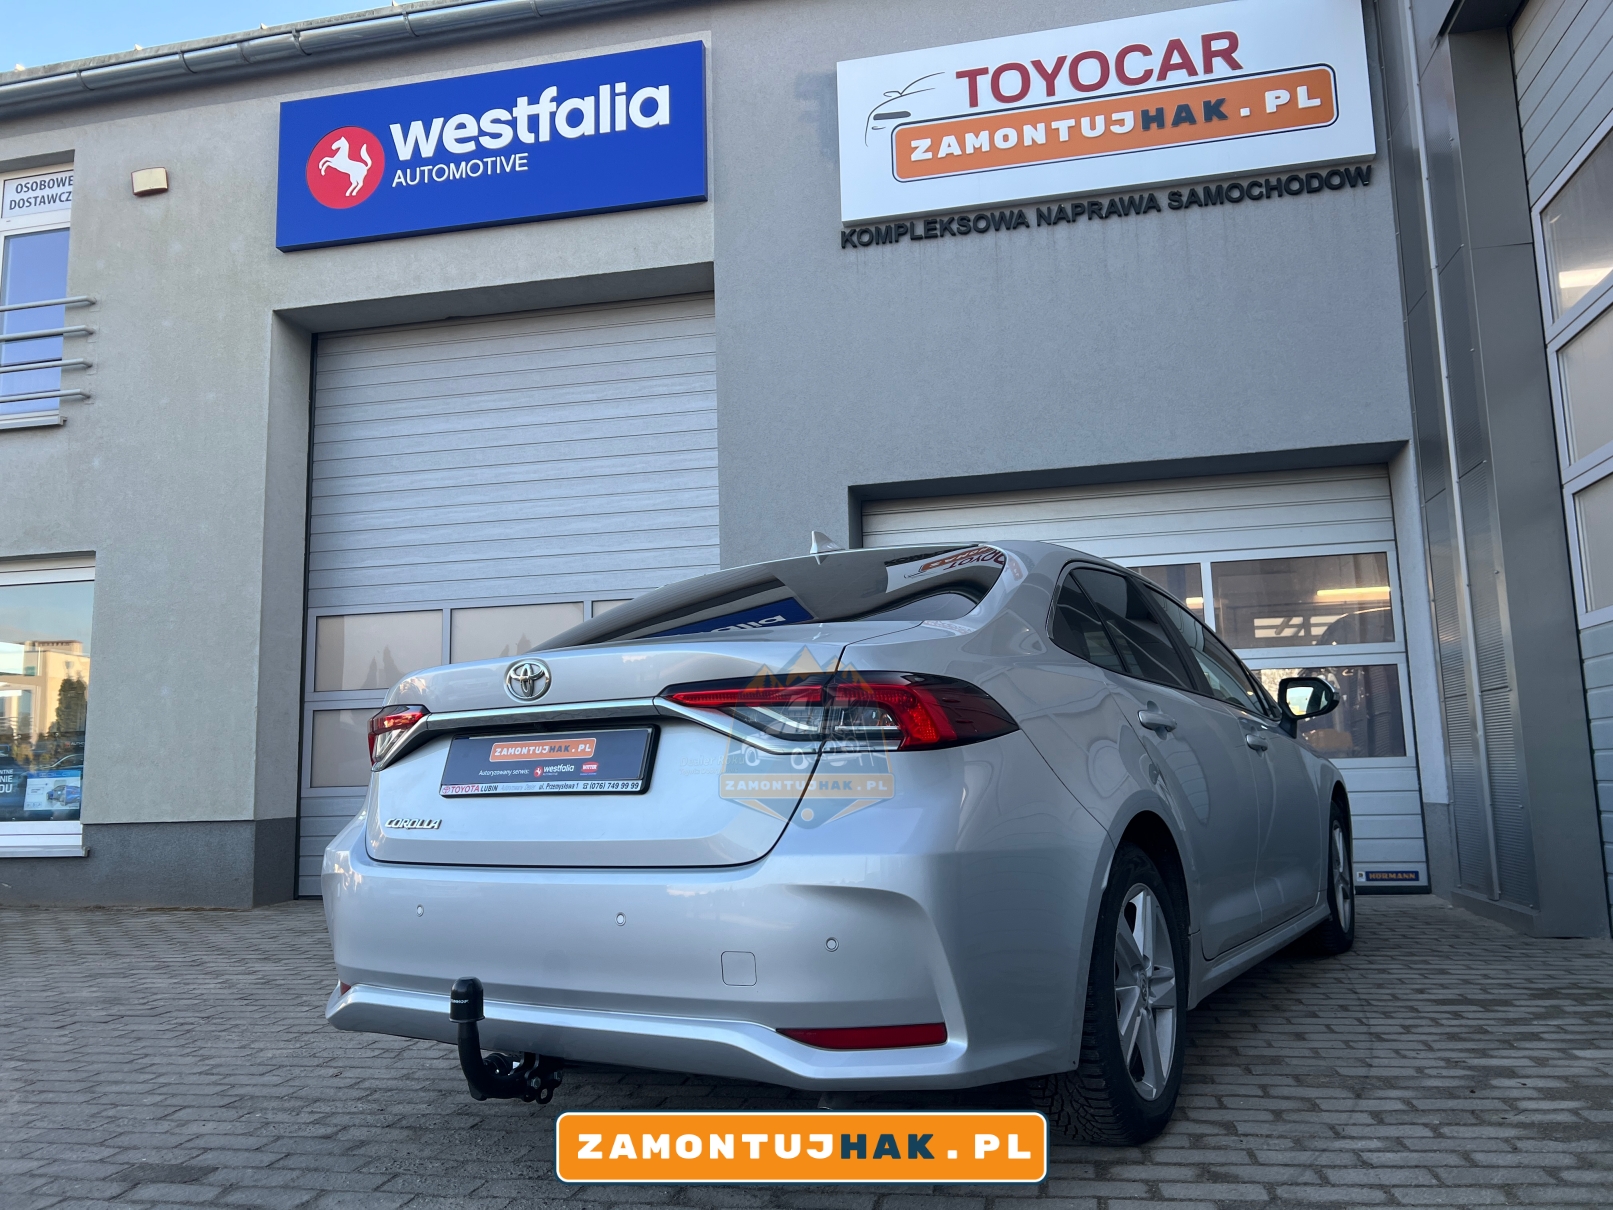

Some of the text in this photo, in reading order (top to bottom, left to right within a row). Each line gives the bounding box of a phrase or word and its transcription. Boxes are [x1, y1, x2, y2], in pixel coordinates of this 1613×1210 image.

[956, 30, 1243, 108] TOYOCAR
[389, 81, 670, 161] westfalia
[392, 153, 528, 187] AUTOMOTIVE
[15, 175, 74, 194] OSOBOWE
[840, 209, 1029, 249] KOMPLEKSOWA
[1036, 192, 1161, 227] NAPRAWA
[543, 763, 575, 773] westfalia
[451, 784, 480, 794] TOYOTA
[589, 782, 605, 790] (076)
[384, 818, 442, 830] COROLLA
